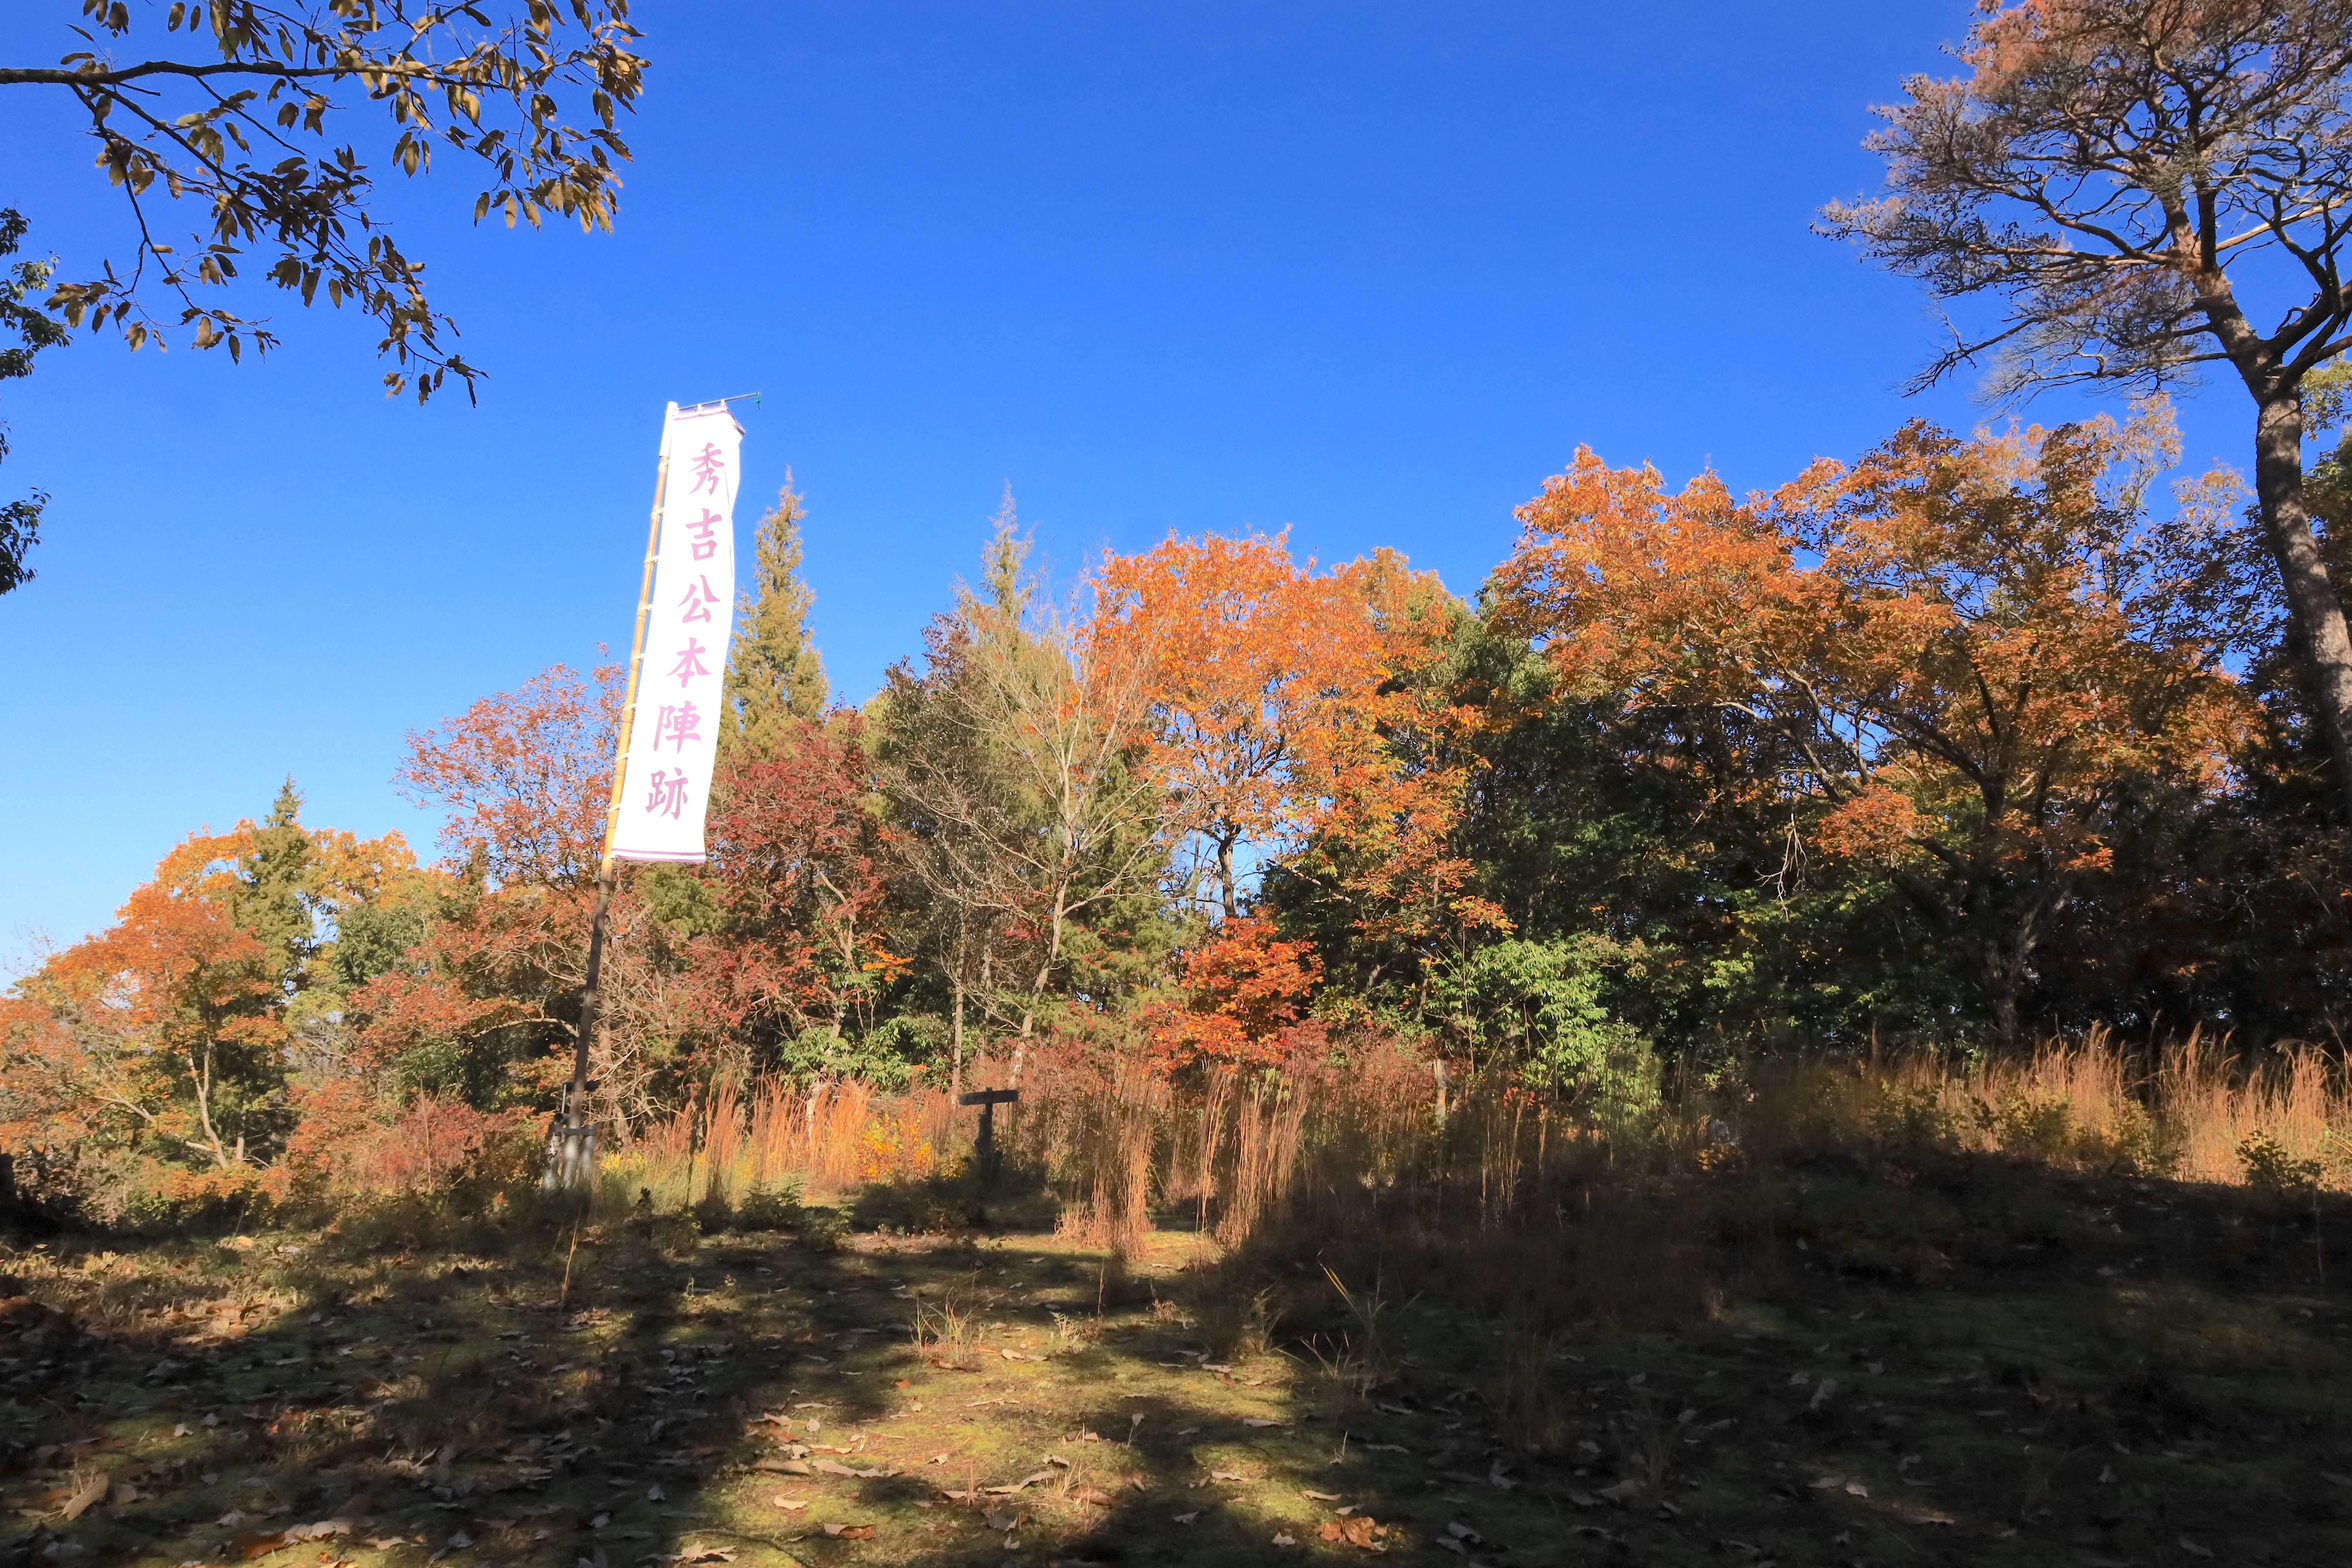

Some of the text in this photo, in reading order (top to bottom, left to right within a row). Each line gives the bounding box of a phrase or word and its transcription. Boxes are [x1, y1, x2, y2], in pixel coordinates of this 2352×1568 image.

[645, 443, 724, 820] 秀吉公本陣跡
